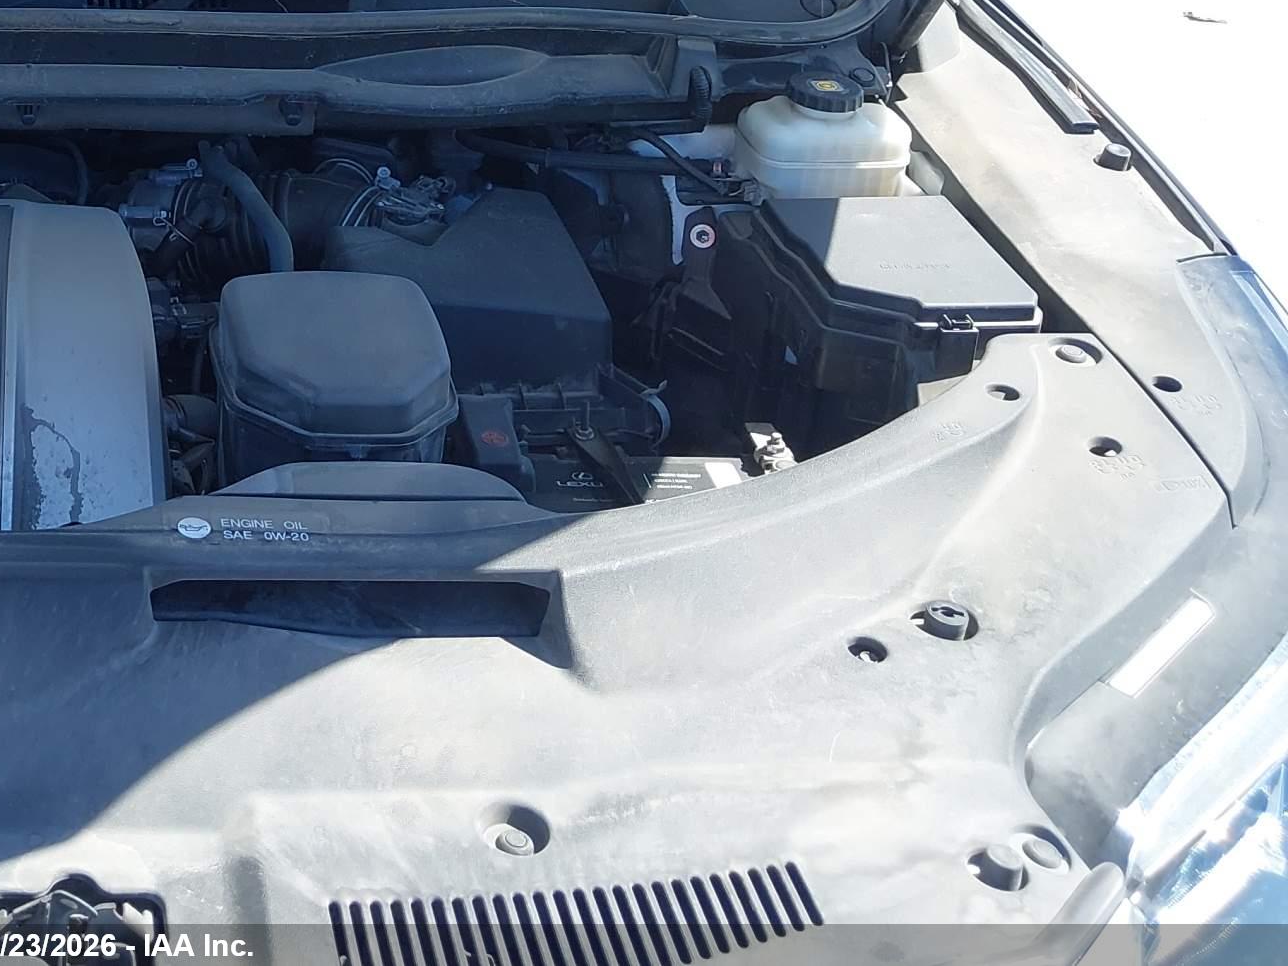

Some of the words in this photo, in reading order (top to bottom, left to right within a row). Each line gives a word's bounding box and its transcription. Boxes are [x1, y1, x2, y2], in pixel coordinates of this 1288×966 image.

[555, 480, 604, 488] LEXU
[220, 518, 273, 529] ENGINE
[283, 520, 308, 530] OIL
[223, 530, 253, 540] SAE
[263, 531, 309, 542] 0W-20
